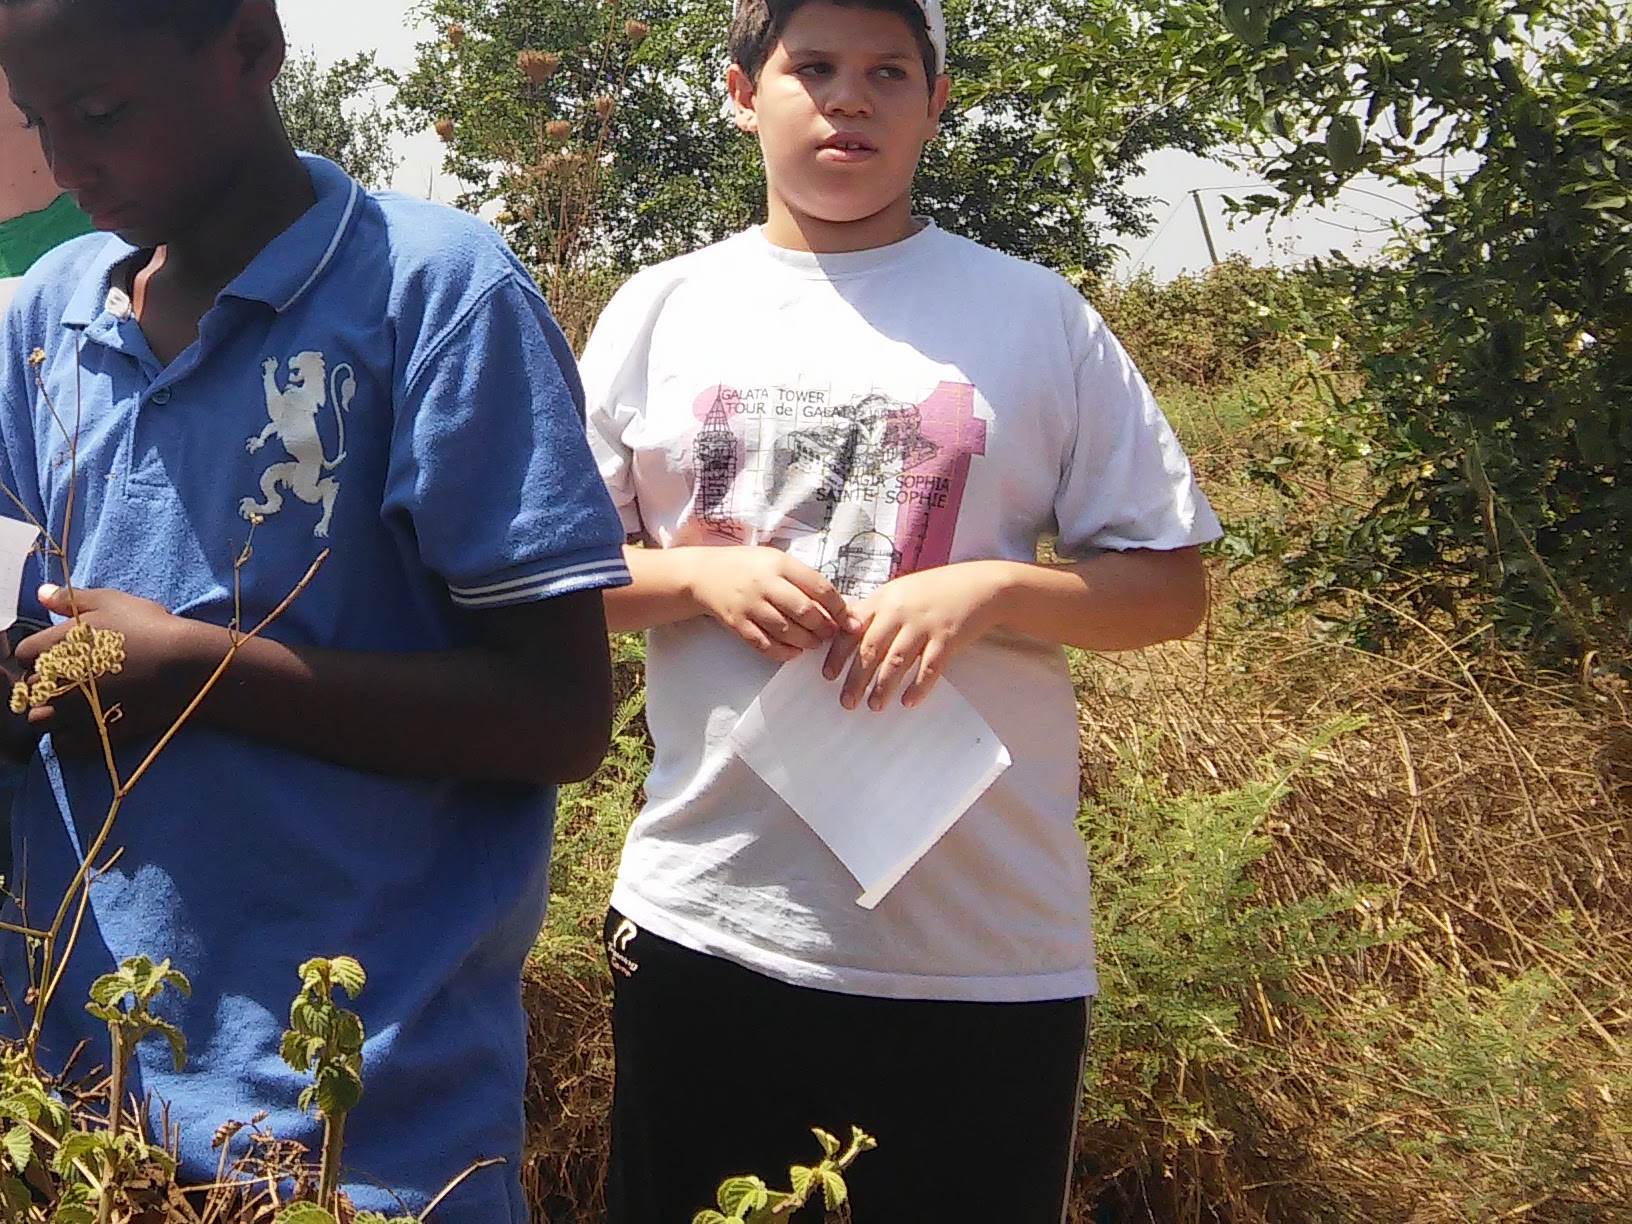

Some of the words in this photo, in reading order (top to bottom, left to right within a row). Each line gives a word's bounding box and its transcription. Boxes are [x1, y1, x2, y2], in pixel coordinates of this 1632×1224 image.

[721, 388, 769, 401] GALATA
[777, 388, 825, 404] TOWER
[725, 402, 767, 415] TOUR
[775, 403, 793, 417] de
[895, 474, 950, 492] SOPHIA
[816, 487, 873, 503] SAINTE
[885, 490, 947, 509] SOPHIE
